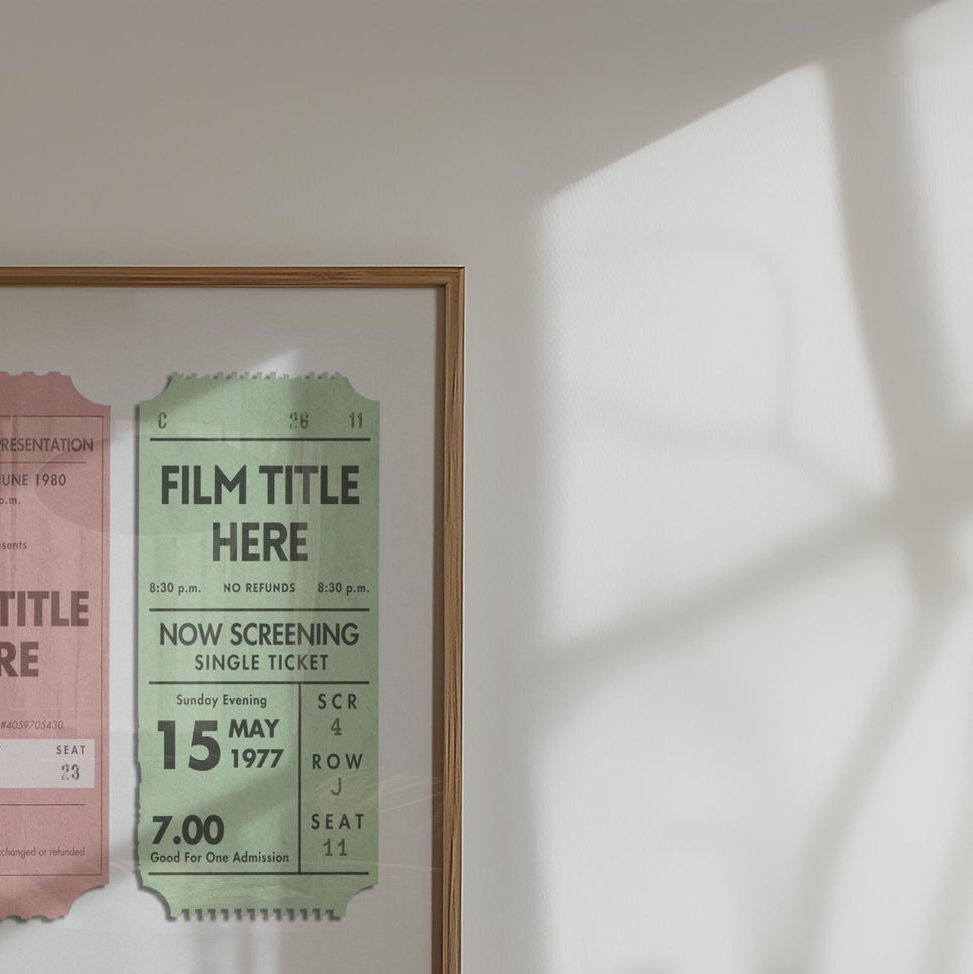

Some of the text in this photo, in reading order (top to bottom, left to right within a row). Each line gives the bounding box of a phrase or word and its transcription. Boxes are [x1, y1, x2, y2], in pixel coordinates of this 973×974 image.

[158, 412, 167, 429] C
[349, 412, 363, 429] 11
[35, 474, 67, 486] 1980
[161, 465, 360, 505] FILM TITLE
[212, 522, 308, 562] HERE
[149, 583, 201, 596] 8:30 p.m.
[223, 583, 295, 593] NO REFUNDS
[318, 583, 370, 596] 8:30 p.m.
[160, 622, 360, 646] NOW SCREENING
[195, 654, 329, 671] SINGLE TICKET
[176, 694, 267, 708] Sunday Evening
[317, 694, 357, 710] SCR
[228, 719, 280, 738] MAY
[331, 717, 342, 736] 4
[56, 746, 86, 755] SEAT
[157, 720, 221, 771] 15
[231, 748, 284, 769] 1977
[312, 753, 363, 769] ROW
[61, 764, 80, 781] 23
[331, 777, 342, 796] J
[152, 815, 225, 845] 7.00
[311, 814, 364, 830] SEAT
[38, 849, 47, 857] or
[49, 848, 85, 857] refunded
[323, 838, 348, 856] 11
[150, 852, 289, 863] Good For One Admission
